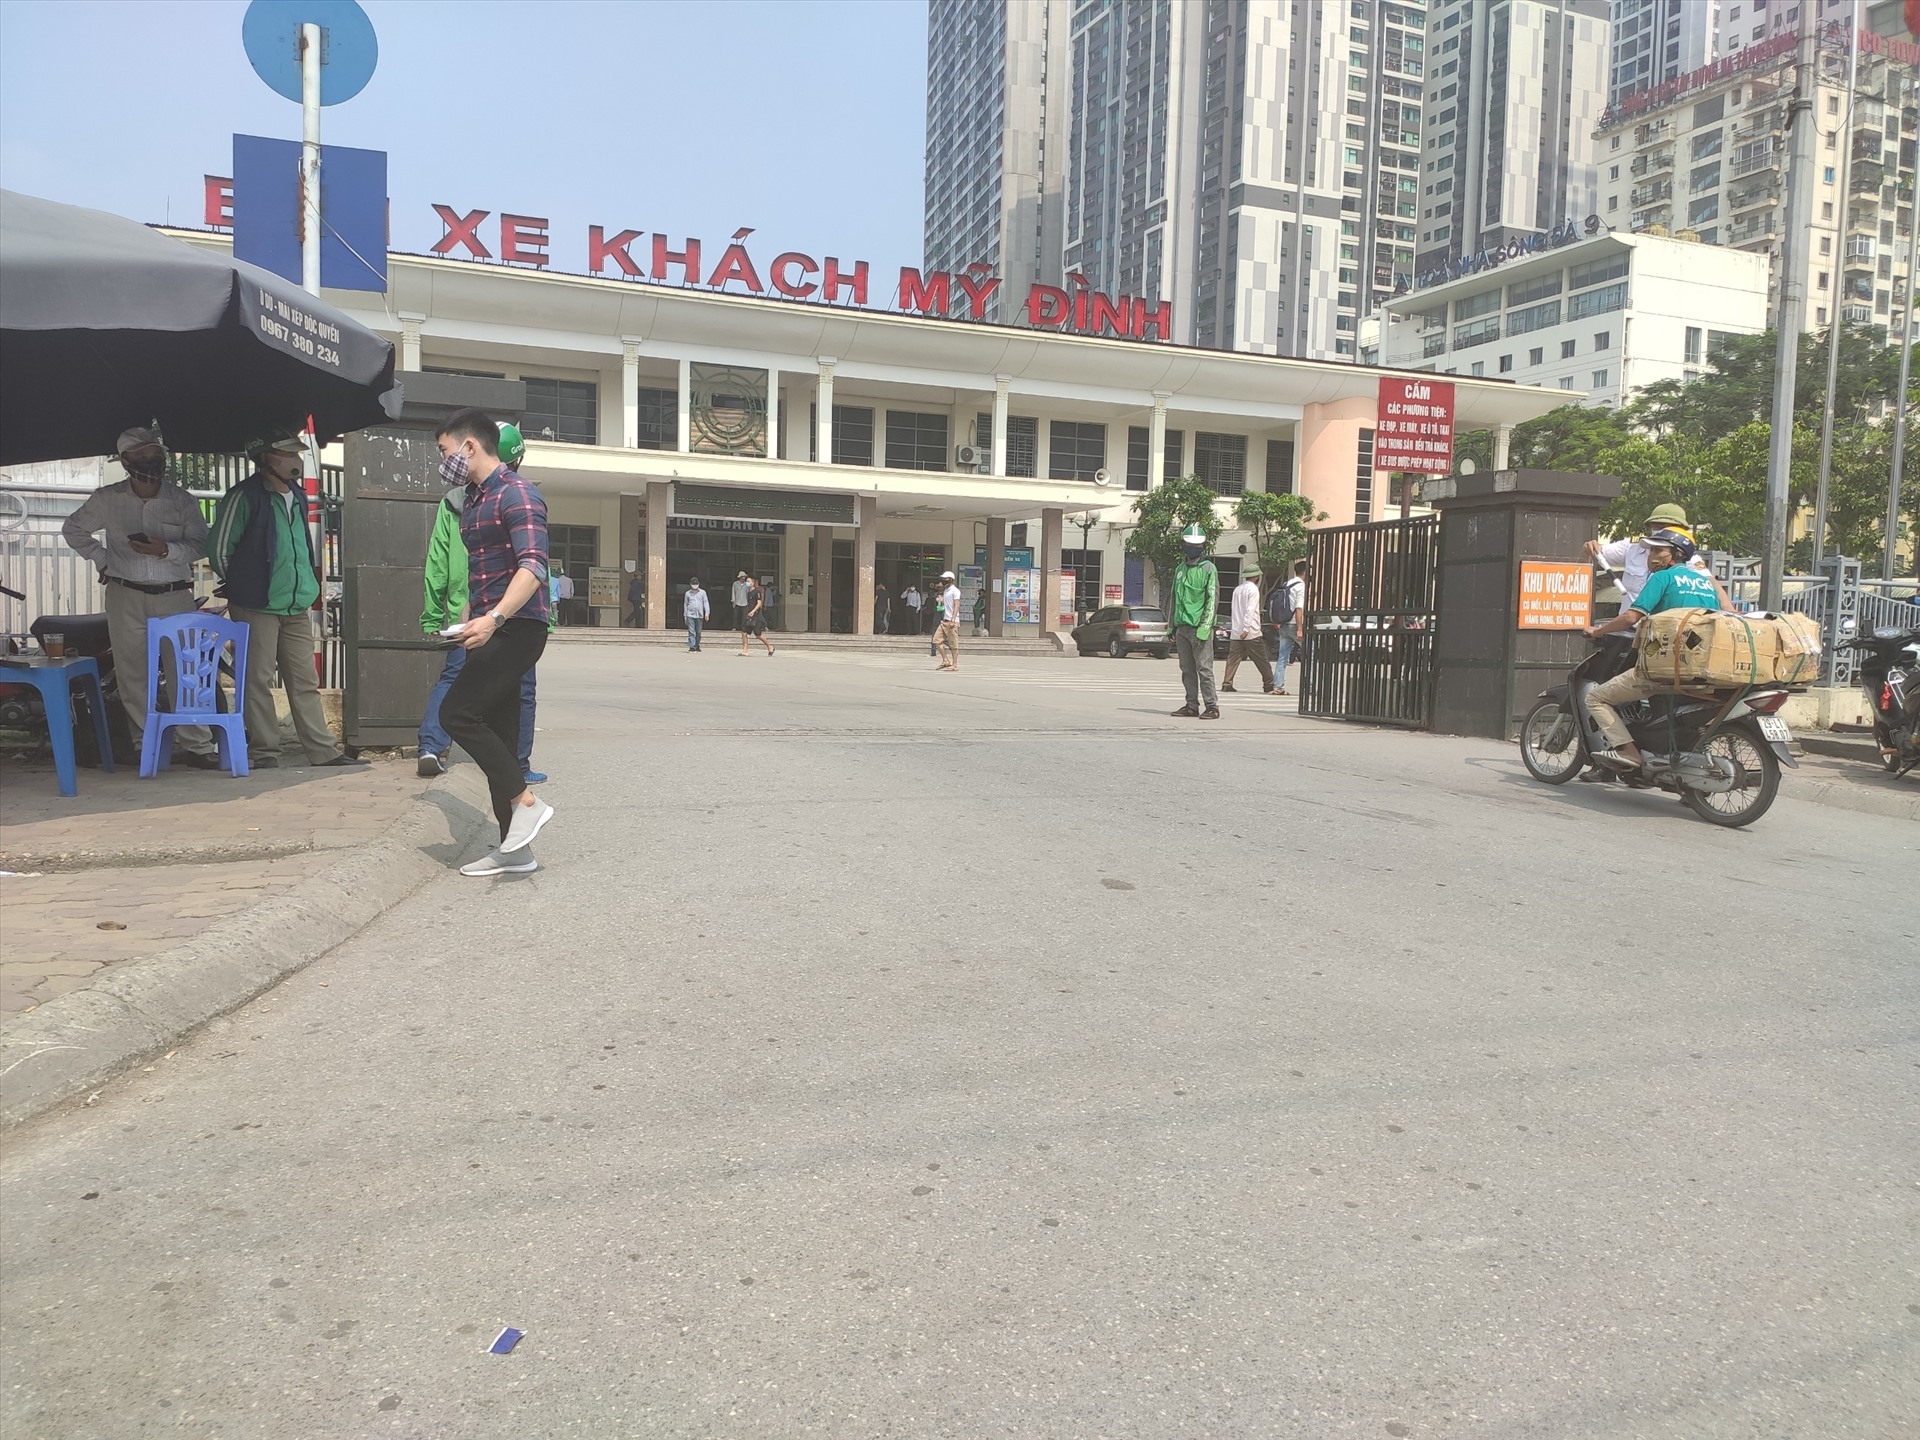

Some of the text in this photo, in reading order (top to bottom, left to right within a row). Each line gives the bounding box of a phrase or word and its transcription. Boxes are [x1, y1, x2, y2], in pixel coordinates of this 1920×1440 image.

[430, 203, 1172, 339] XE KHÁCH MỸ ĐÌNH
[260, 314, 340, 367] 0967 380 234
[1405, 380, 1431, 400] CẤM
[1387, 401, 1401, 415] CÁC
[1402, 404, 1429, 417] PHƯƠNG
[1379, 420, 1386, 431] XE
[1399, 421, 1407, 432] XE
[1420, 423, 1427, 434] XE
[1524, 566, 1589, 598] KHU VỰC CẤM
[1563, 601, 1570, 610] XE
[1555, 615, 1563, 625] XE
